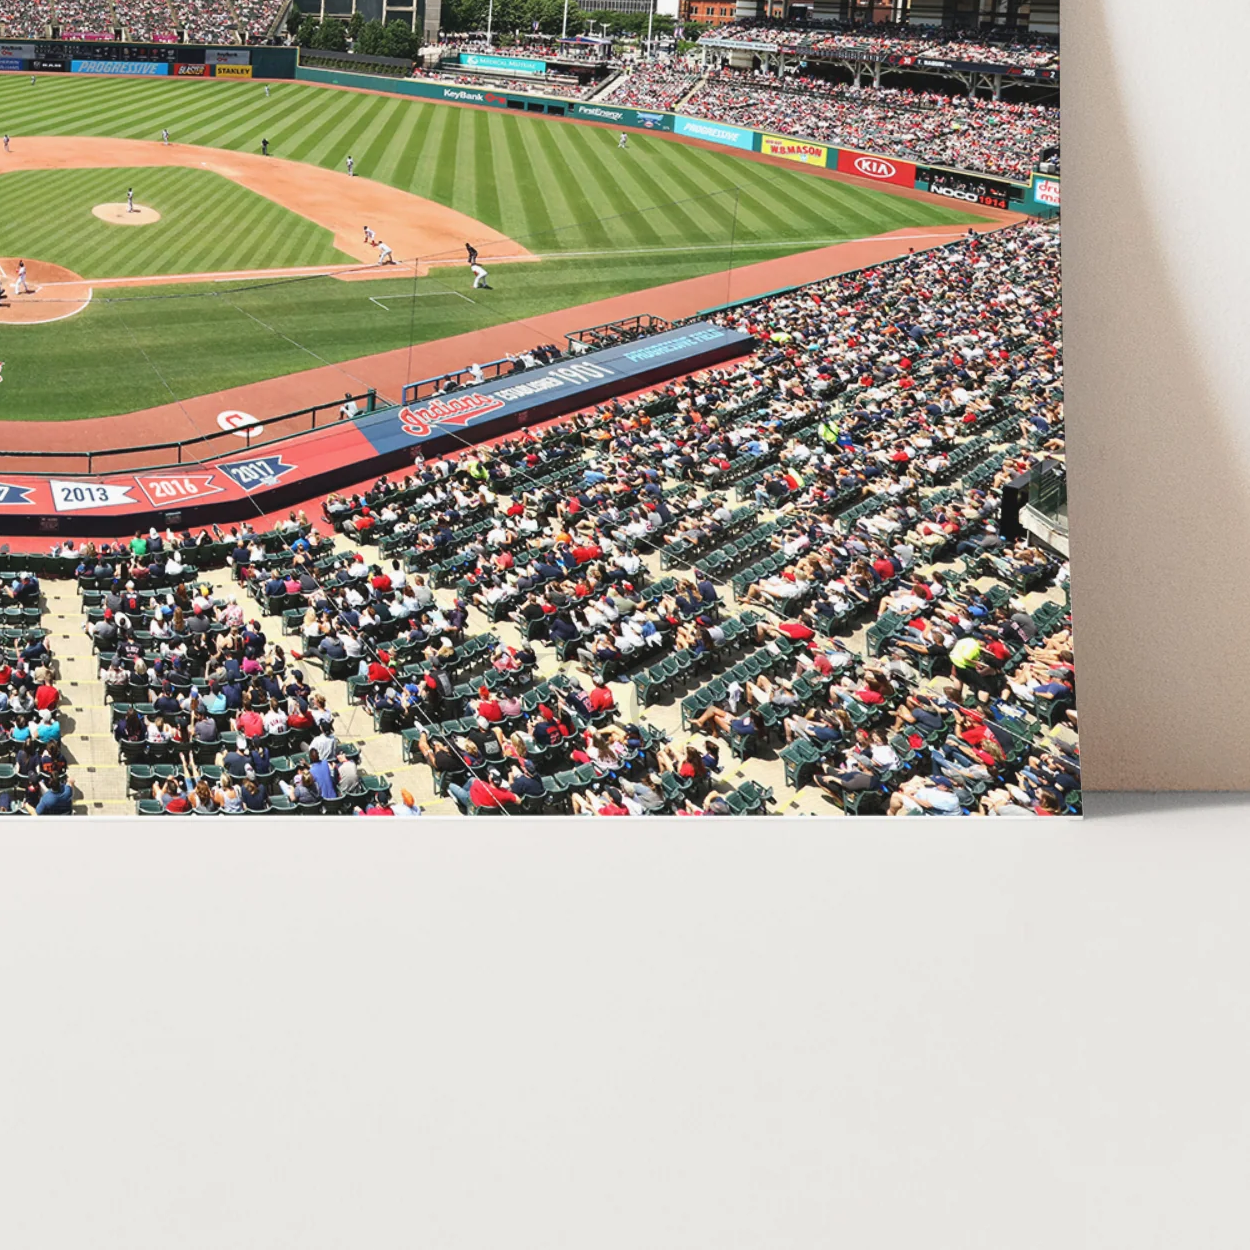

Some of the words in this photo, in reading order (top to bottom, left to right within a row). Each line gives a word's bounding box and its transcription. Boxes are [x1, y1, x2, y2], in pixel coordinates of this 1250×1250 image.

[78, 61, 159, 75] PROGRESSIVE
[217, 66, 250, 75] STANLEY
[444, 89, 484, 101] KeyBank
[683, 122, 741, 142] PROGRESSIVE
[861, 159, 889, 176] KIA
[930, 184, 979, 203] NOCO
[979, 196, 1007, 209] 1914
[399, 392, 505, 437] Indians
[494, 375, 564, 402] ESTABLISHED
[550, 361, 615, 385] 1901
[230, 460, 275, 483] 2017
[61, 487, 109, 502] 2013
[149, 479, 199, 498] 2016
